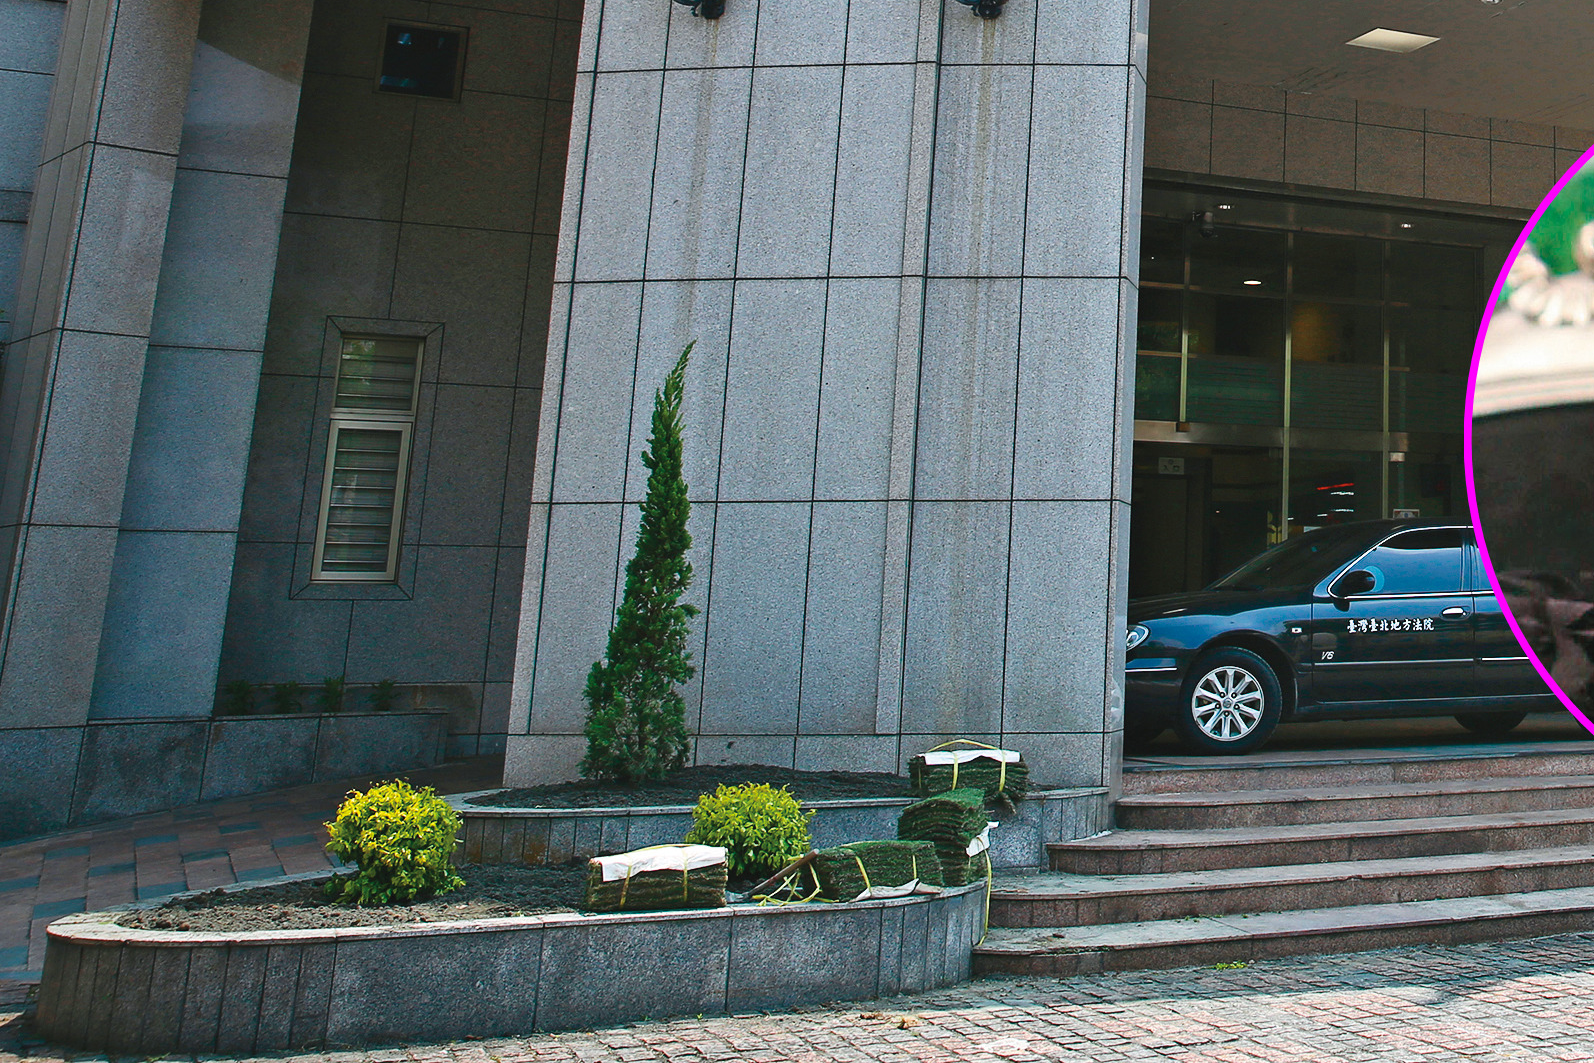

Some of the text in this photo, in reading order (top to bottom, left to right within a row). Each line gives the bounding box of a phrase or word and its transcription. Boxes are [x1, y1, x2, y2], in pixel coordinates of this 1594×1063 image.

[1346, 617, 1435, 634] 臺灣臺北地方法院
[1321, 651, 1335, 660] V6
